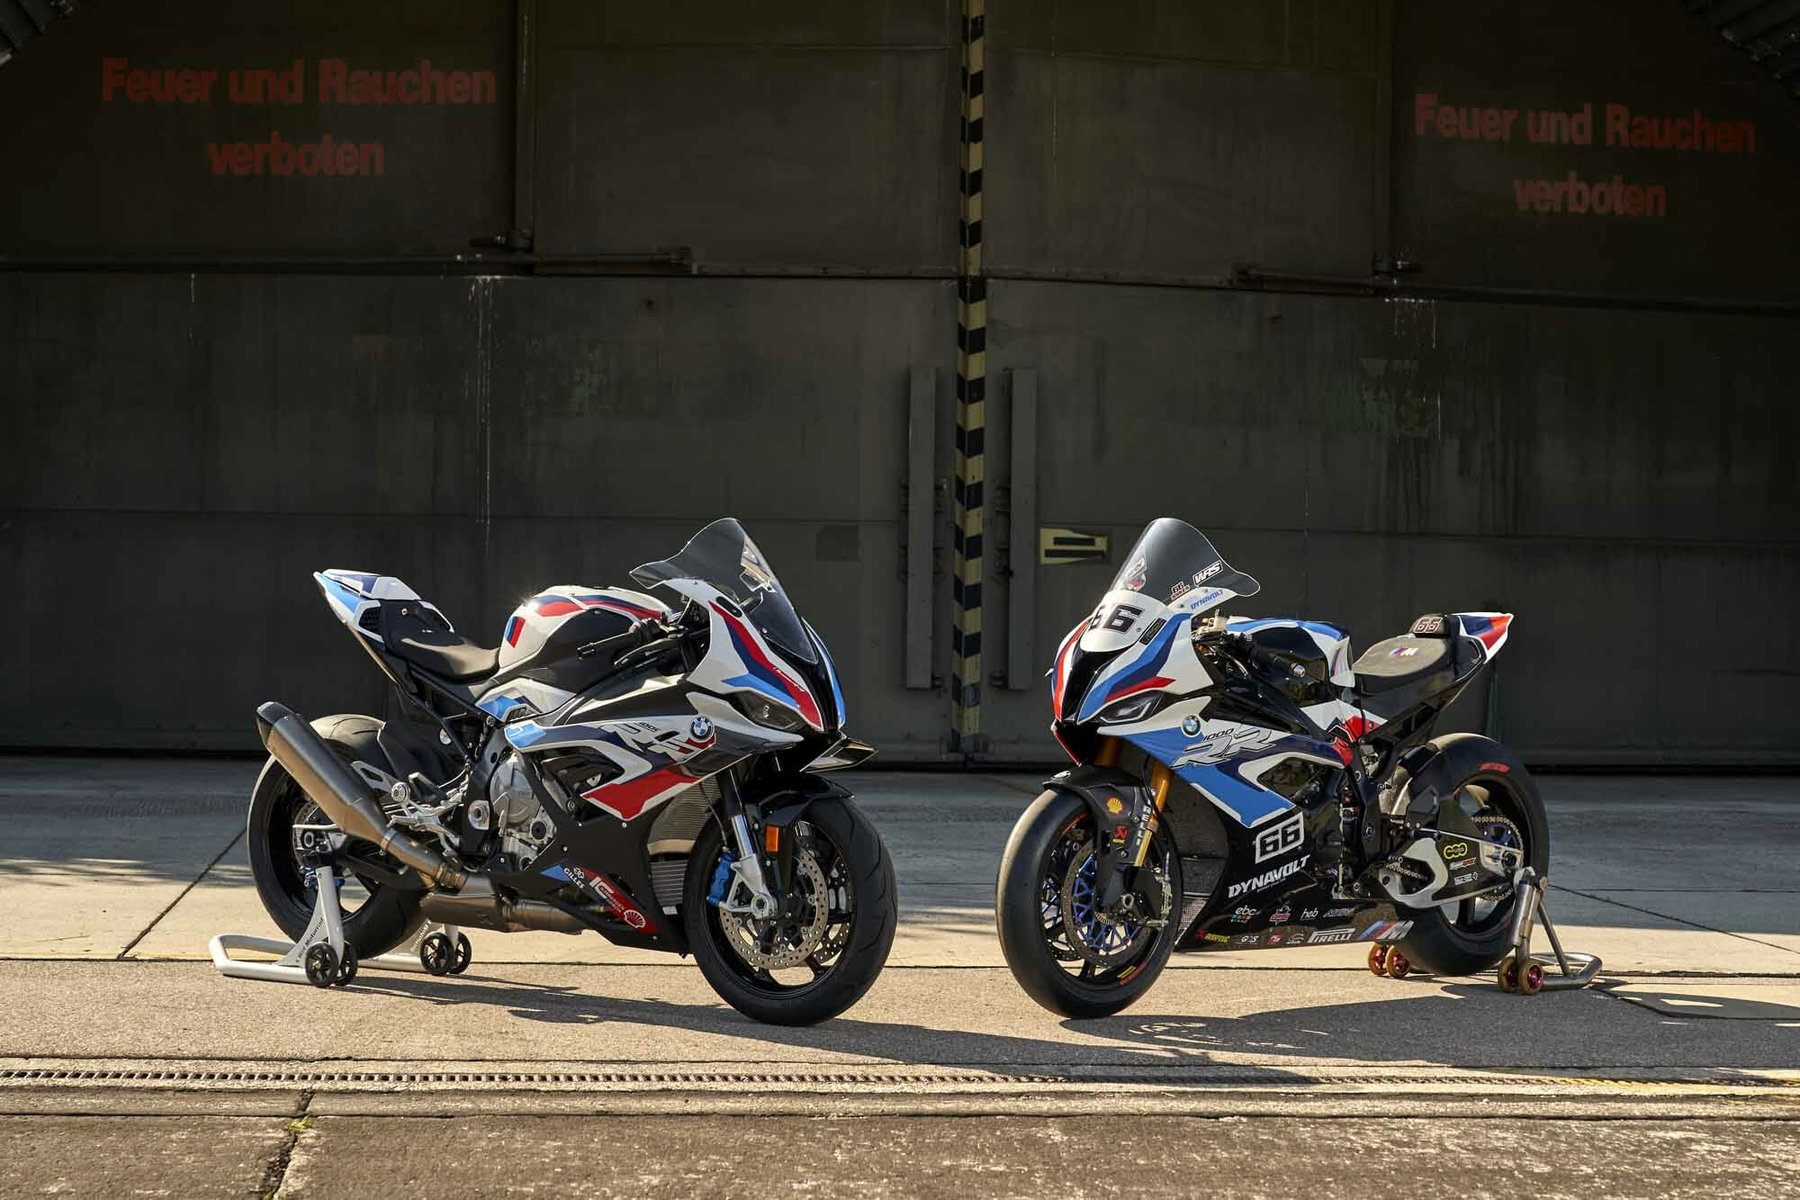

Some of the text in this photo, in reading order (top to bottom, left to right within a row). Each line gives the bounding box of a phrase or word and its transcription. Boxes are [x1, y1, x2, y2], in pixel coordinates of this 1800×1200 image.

[103, 57, 496, 104] Feuer und Rauchen
[1415, 93, 1757, 154] Feuer und Rauchen
[208, 130, 385, 176] verboten
[1513, 171, 1667, 217] verboten
[1413, 616, 1442, 633] 66
[1203, 728, 1235, 741] 1000
[1256, 812, 1304, 863] 66
[563, 867, 585, 889] GILLES
[1228, 854, 1311, 898] DYNAVOLT
[1308, 928, 1355, 943] PIRELLI
